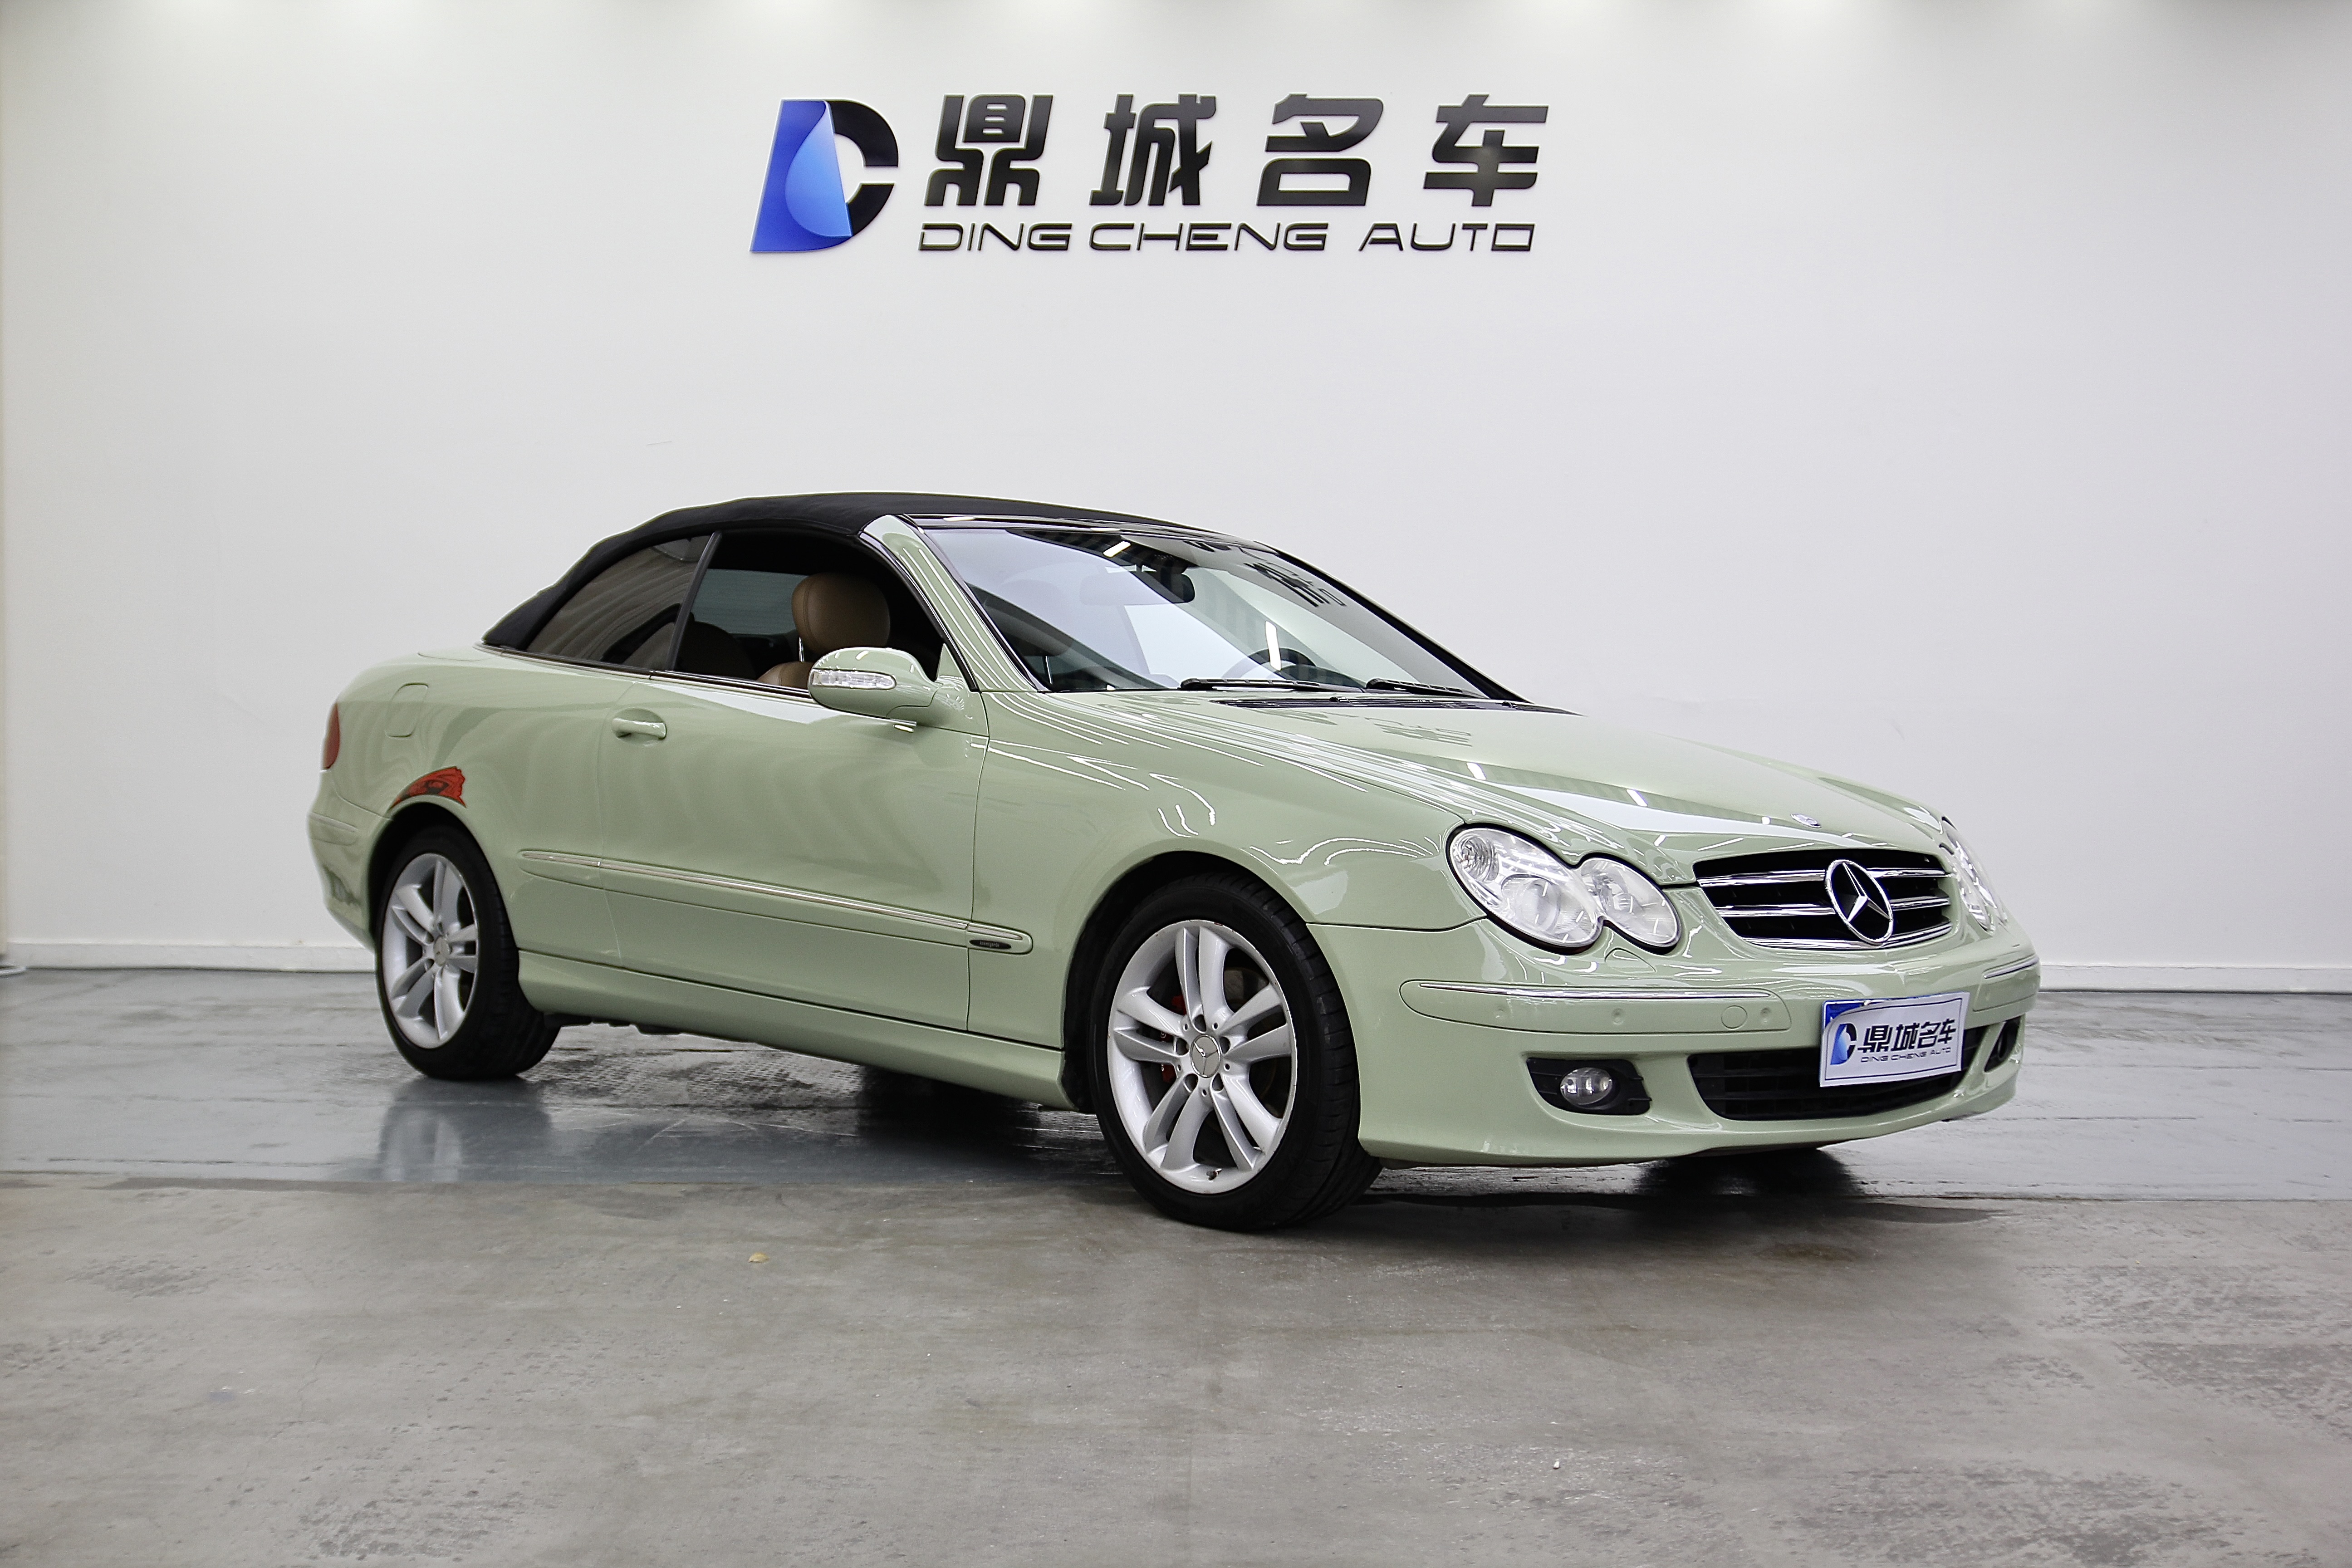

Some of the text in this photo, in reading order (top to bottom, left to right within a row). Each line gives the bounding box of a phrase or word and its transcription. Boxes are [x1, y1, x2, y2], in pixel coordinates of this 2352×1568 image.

[923, 93, 1549, 207] 鼎城名车
[917, 222, 1535, 252] DING CHENG AUTO
[1858, 1019, 1956, 1053] 鼎城名车
[1891, 1051, 1927, 1061] CHENG
[1929, 1047, 1951, 1055] AUTO
